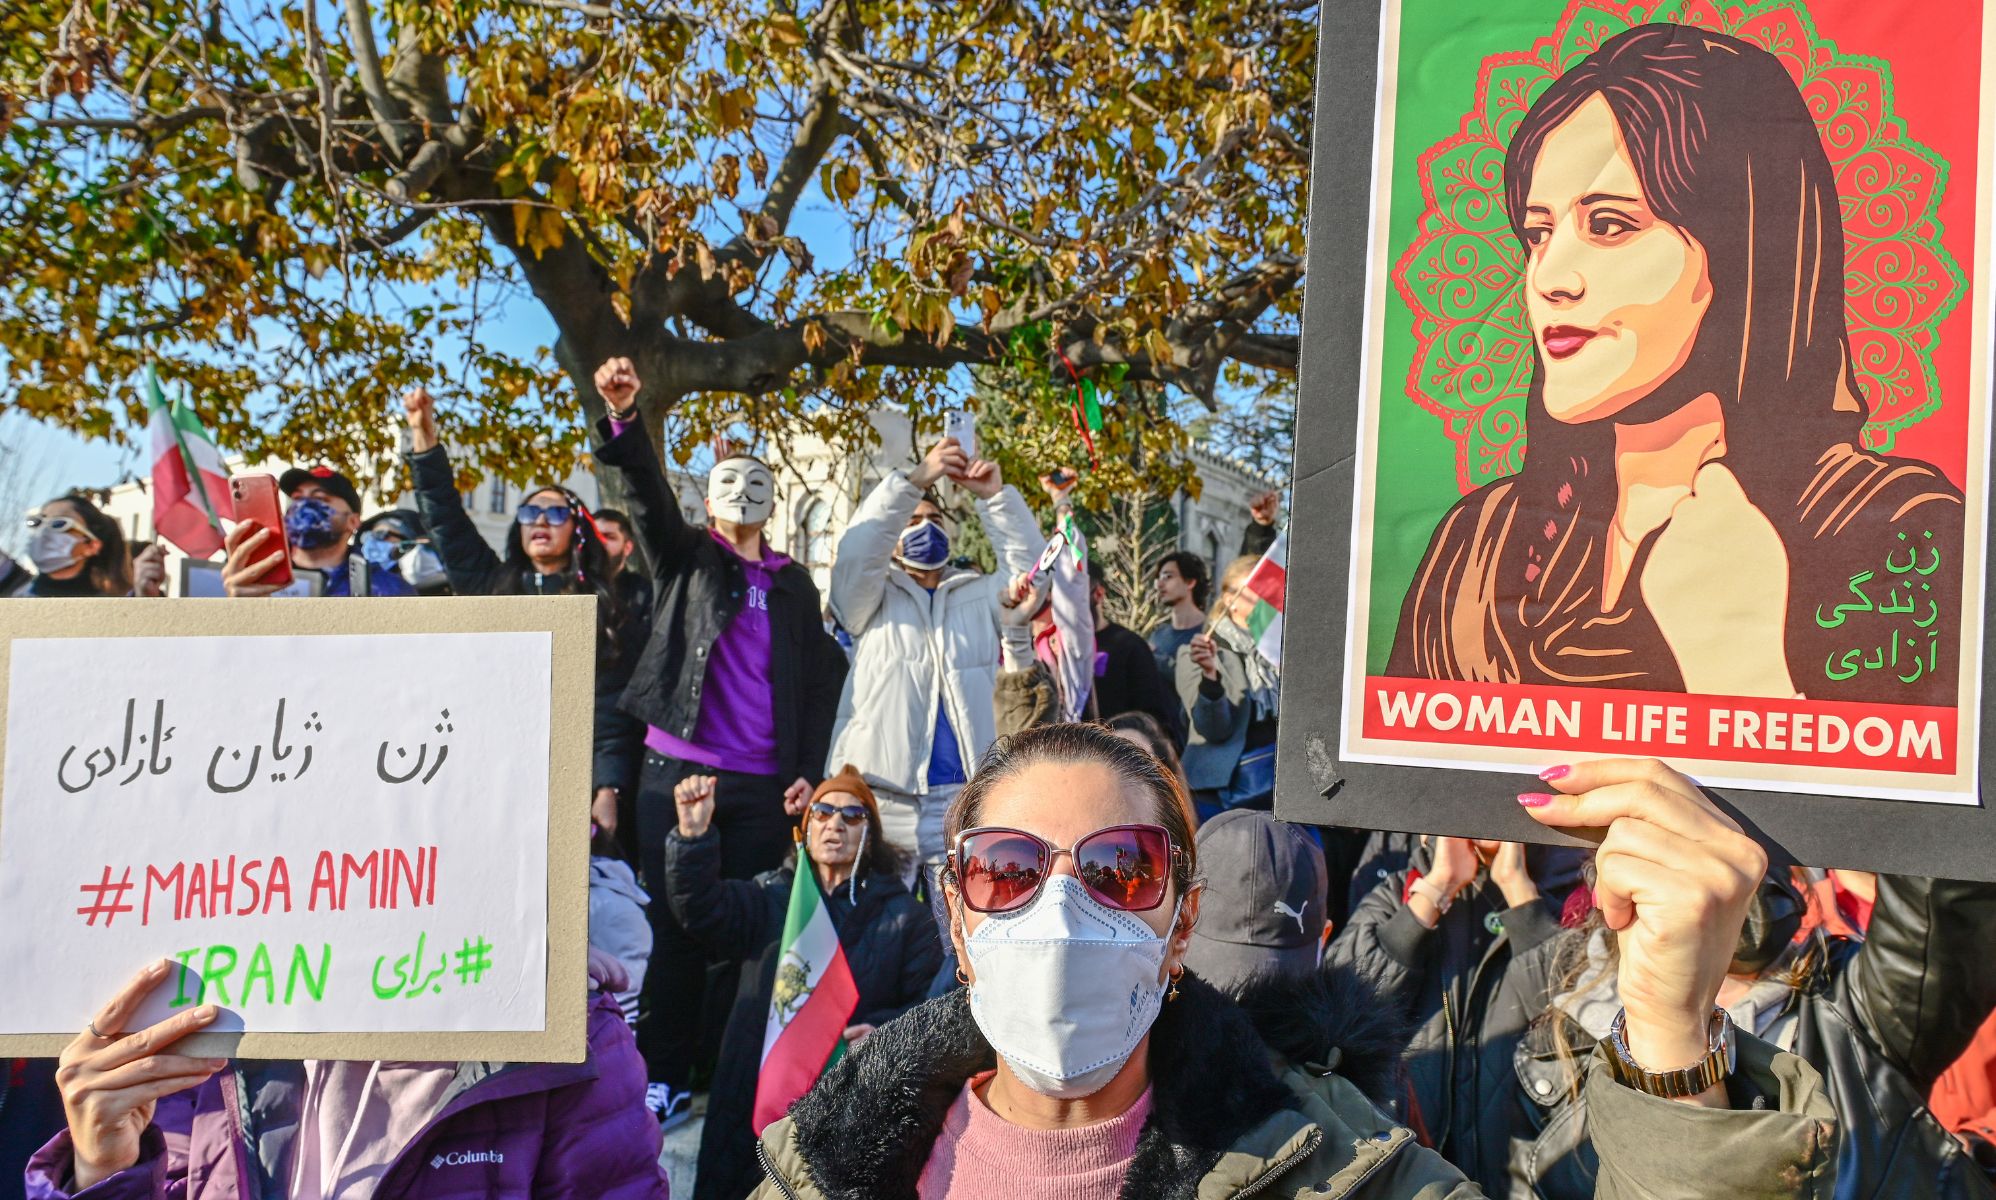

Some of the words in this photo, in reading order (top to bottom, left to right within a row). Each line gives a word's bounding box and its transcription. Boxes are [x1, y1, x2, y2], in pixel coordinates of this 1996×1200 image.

[1886, 530, 1941, 575] زن
[1815, 570, 1938, 629] زندگی
[1825, 629, 1939, 684] آزادی
[57, 697, 176, 794] ئازادی
[206, 697, 323, 794] ژیان
[376, 708, 454, 785] ژن
[1377, 690, 1582, 738] WOMAN
[1601, 703, 1688, 745] LIFE
[1708, 709, 1943, 760] FREEDOM
[77, 854, 292, 928] #MAHSA
[308, 846, 438, 912] AMINI
[169, 942, 332, 1008] IRAN
[371, 931, 494, 1001] #برای
